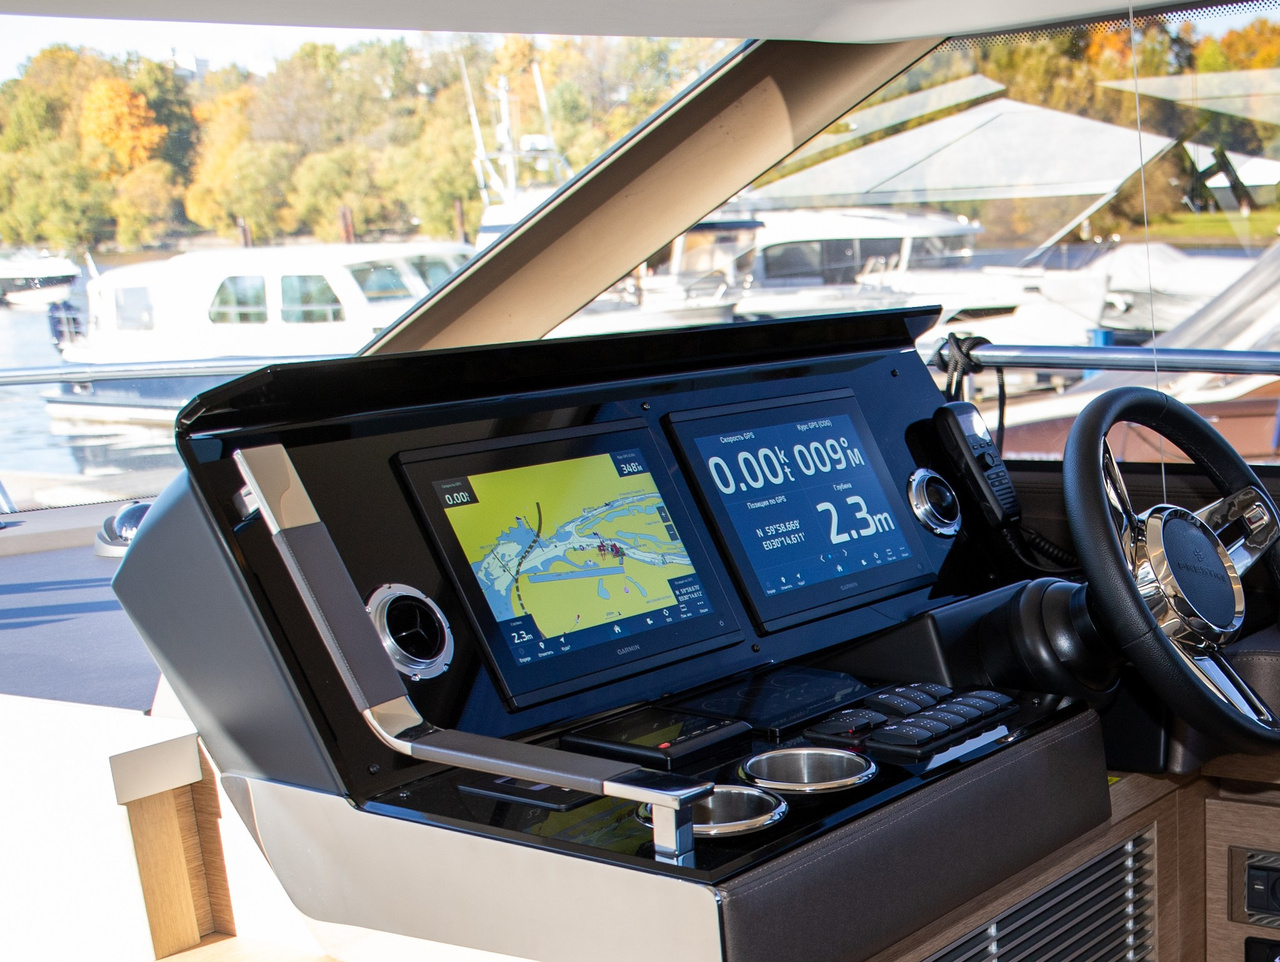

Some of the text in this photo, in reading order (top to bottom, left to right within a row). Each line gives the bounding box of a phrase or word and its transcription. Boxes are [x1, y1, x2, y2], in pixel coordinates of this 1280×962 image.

[808, 421, 819, 429] GPS
[720, 432, 755, 444] Скорость GPS
[708, 448, 785, 494] 0.00
[832, 483, 852, 492] Глубина
[445, 492, 467, 505] 0.00
[746, 499, 769, 509] Позиция
[775, 495, 787, 504] GPS
[756, 528, 764, 538] N
[617, 644, 641, 655] GARMIN
